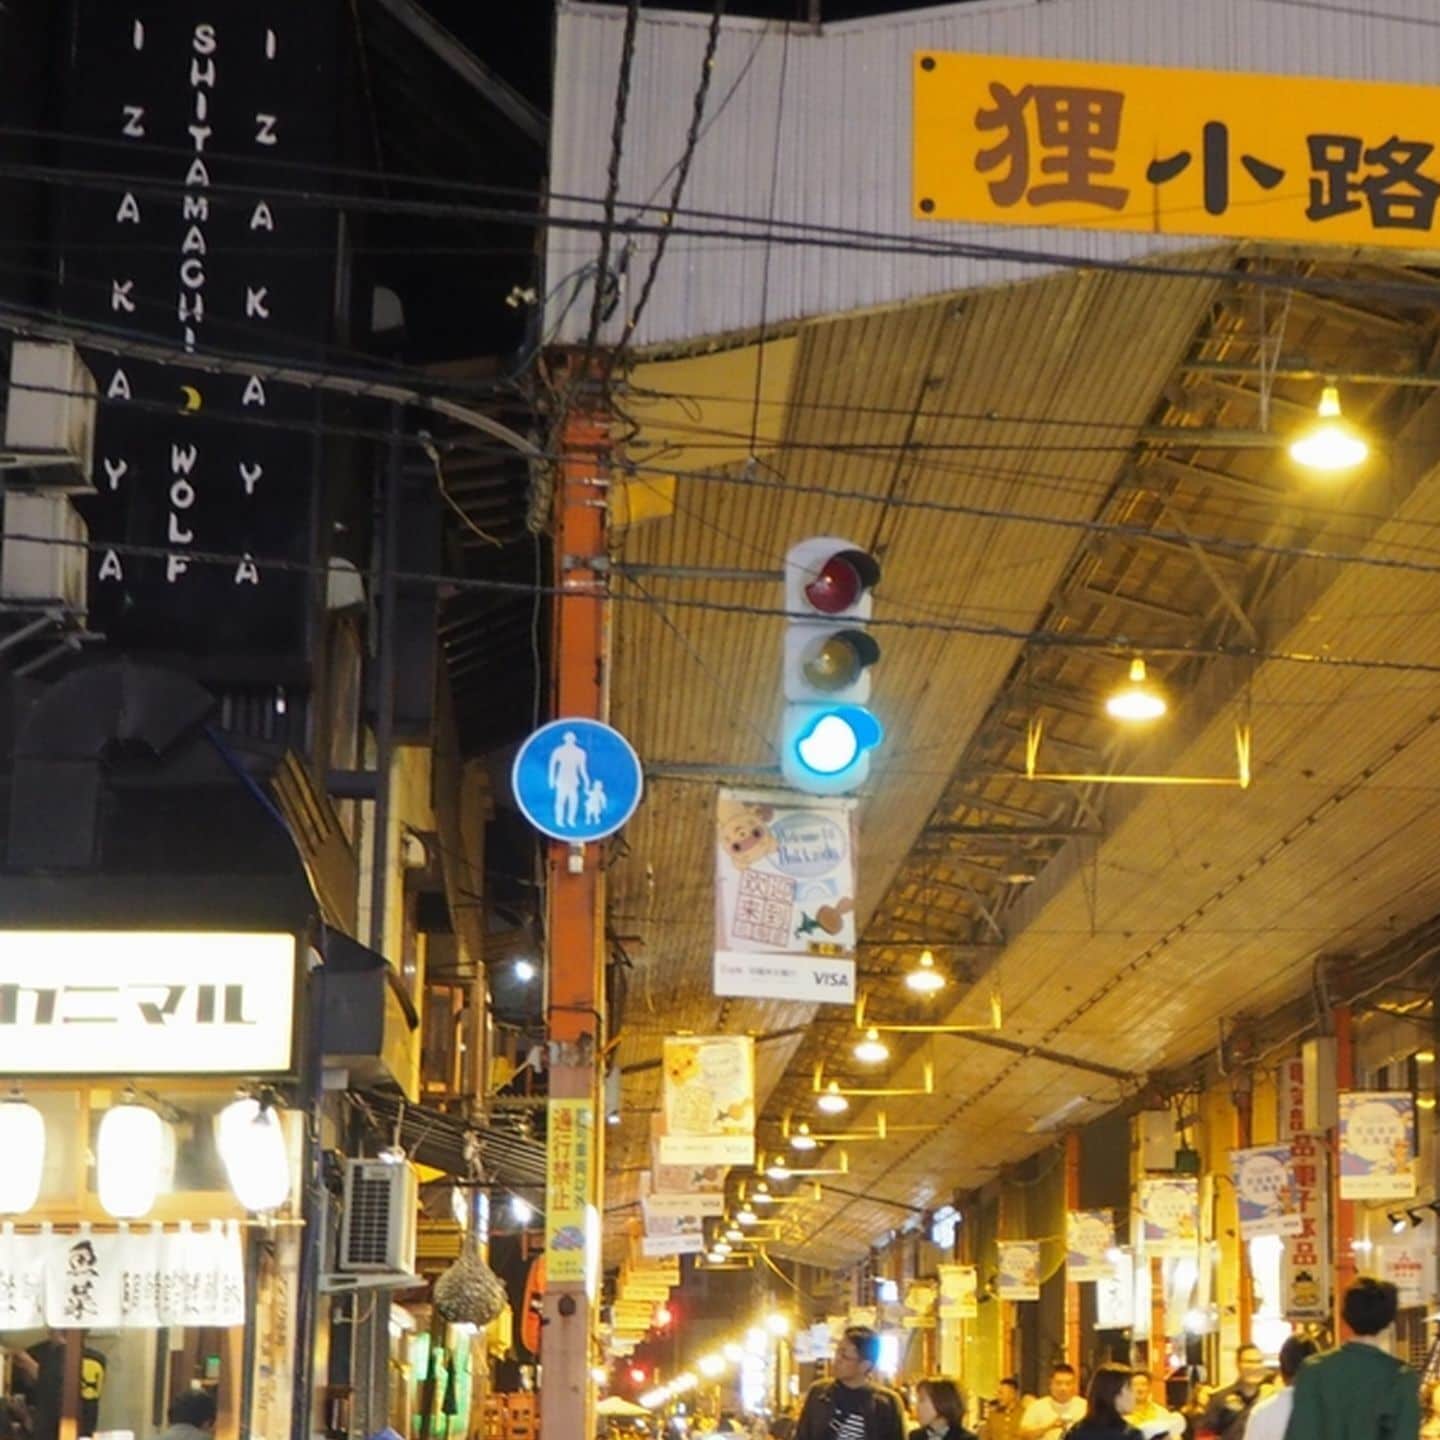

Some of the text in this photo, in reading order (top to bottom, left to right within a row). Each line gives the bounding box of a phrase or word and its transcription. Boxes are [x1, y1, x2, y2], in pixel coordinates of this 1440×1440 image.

[98, 19, 146, 583] IZAKAYA
[166, 24, 217, 585] SHITAMACHI WOLF
[233, 27, 279, 586] IZAKAYA
[0, 983, 257, 1026] カニマル
[813, 971, 849, 987] VISA
[551, 1107, 573, 1212] 通行禁止
